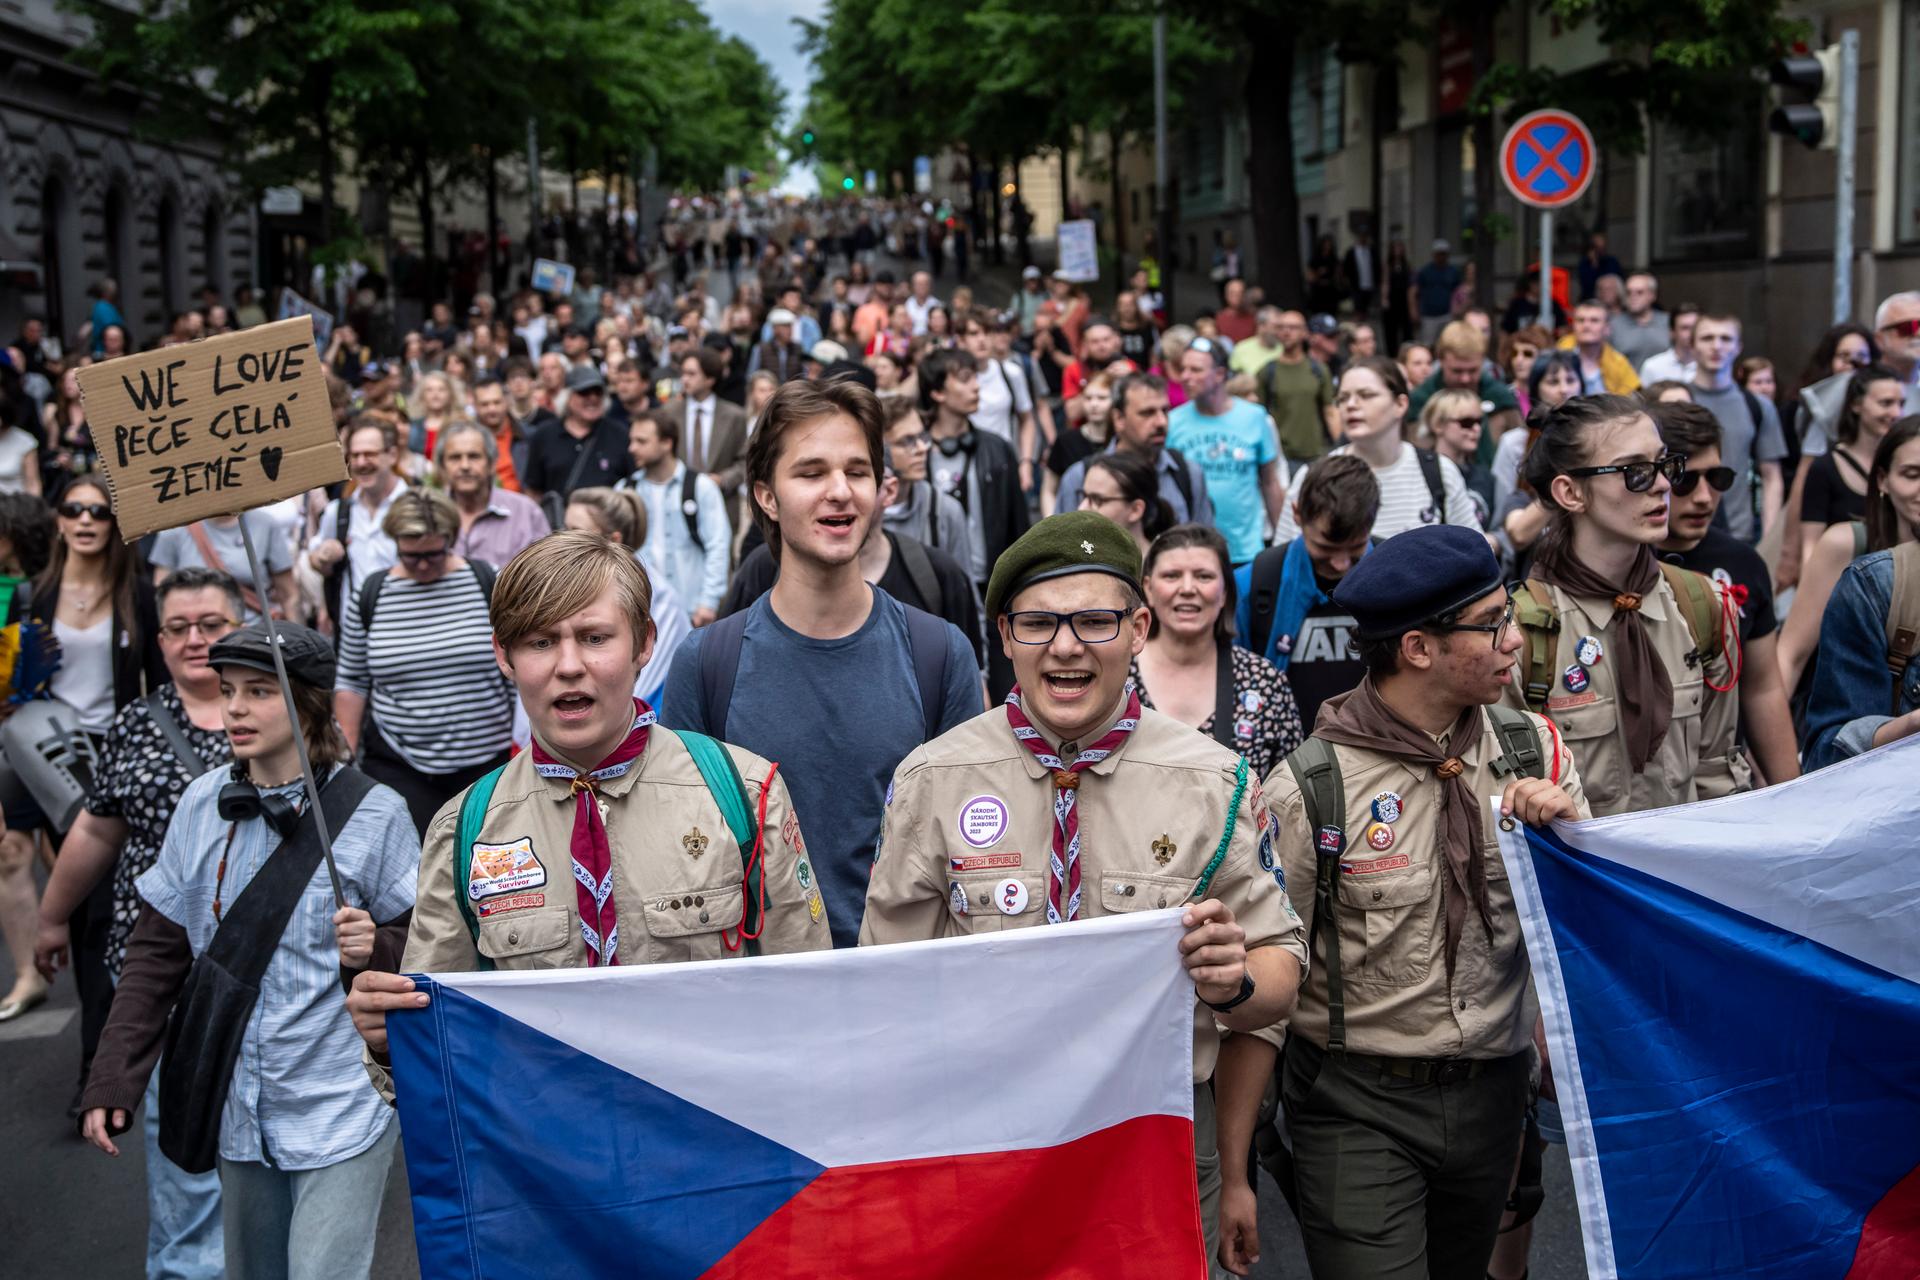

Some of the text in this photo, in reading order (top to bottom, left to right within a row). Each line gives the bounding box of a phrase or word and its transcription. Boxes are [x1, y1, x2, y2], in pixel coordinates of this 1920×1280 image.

[122, 343, 310, 411] WE LOVE
[115, 393, 298, 467] PEČE CELÁ
[150, 443, 248, 503] ZEMĚ
[963, 855, 1019, 868] CZECH REPUBLIC
[1352, 857, 1407, 872] CZECH REPUBLIC
[517, 871, 541, 881] Jamboree
[498, 880, 529, 889] Survivor
[490, 896, 543, 911] CZECH REPUBLIC
